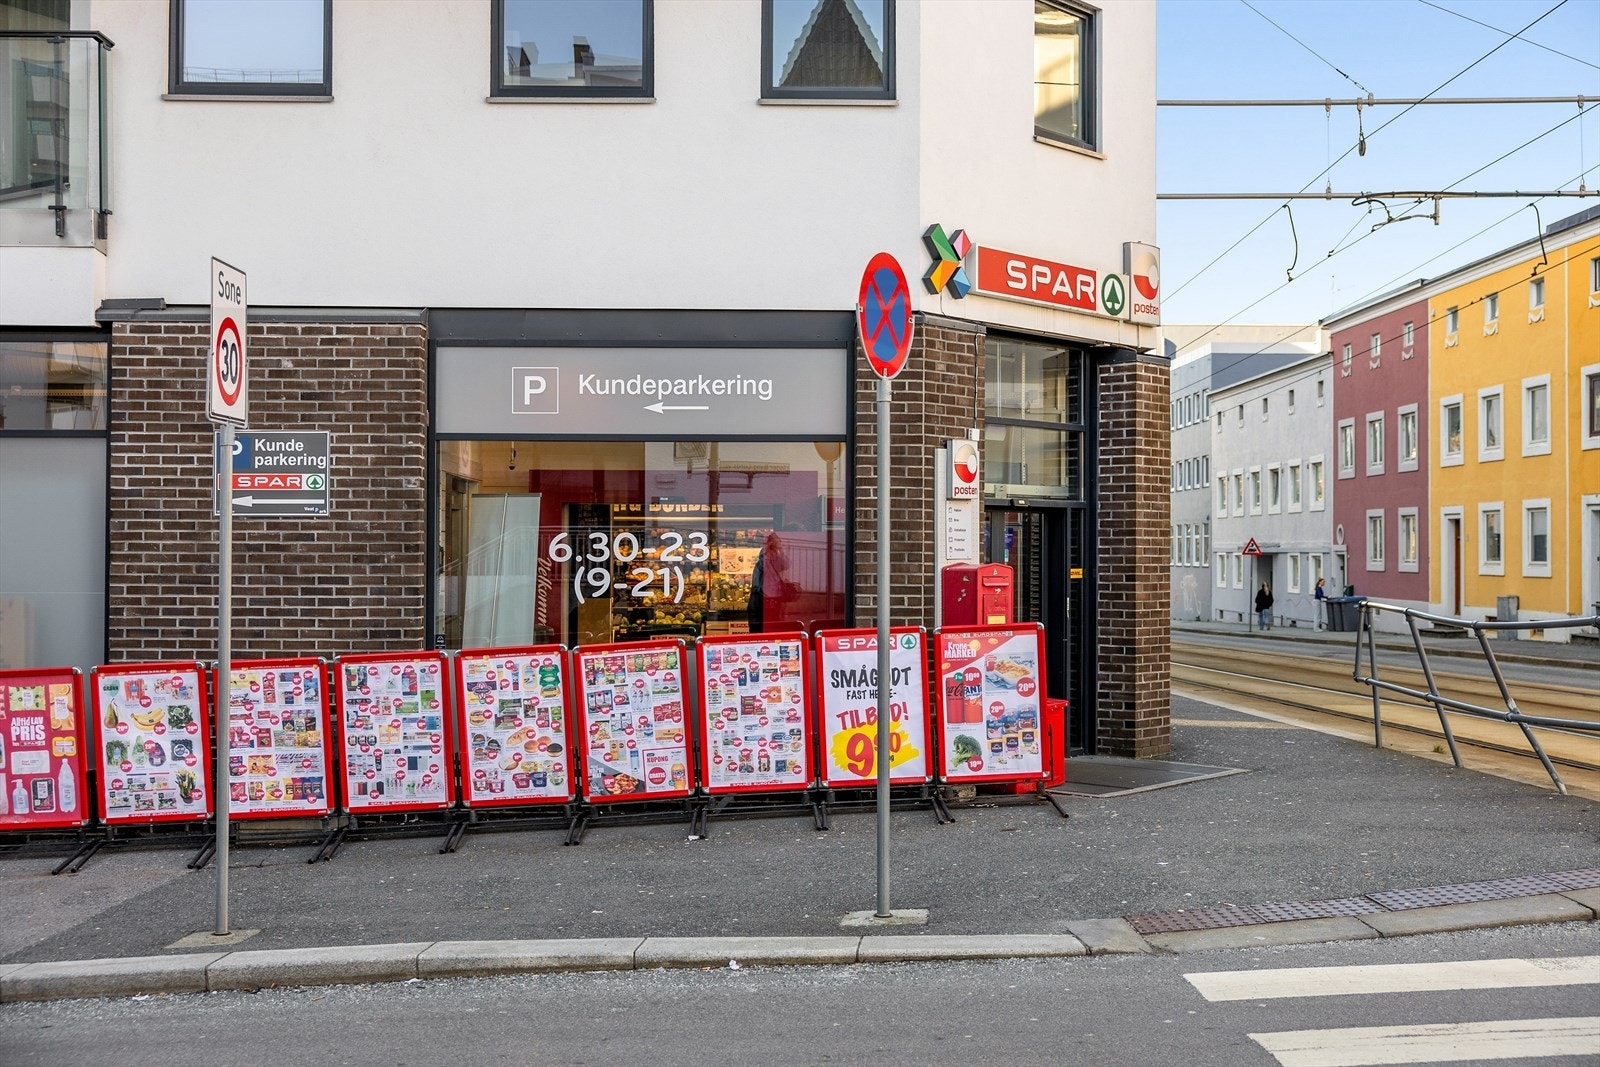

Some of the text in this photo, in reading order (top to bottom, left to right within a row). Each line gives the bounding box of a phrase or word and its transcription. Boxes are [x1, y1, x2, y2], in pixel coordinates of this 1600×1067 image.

[218, 270, 241, 305] Sone
[1006, 259, 1095, 303] SPAR
[221, 339, 238, 385] 30
[524, 375, 547, 405] P
[578, 374, 773, 401] Kundeparkering
[254, 438, 304, 452] Kunde
[254, 453, 327, 469] parkering
[237, 476, 301, 488] SPAR
[549, 531, 710, 562] 6.30-23
[574, 565, 686, 605] (9-21)
[830, 664, 911, 689] SMÅGDT
[846, 688, 897, 700] FAST HEE-
[835, 701, 909, 731] TILBD!
[11, 724, 46, 741] PRIS
[846, 732, 901, 778] 90
